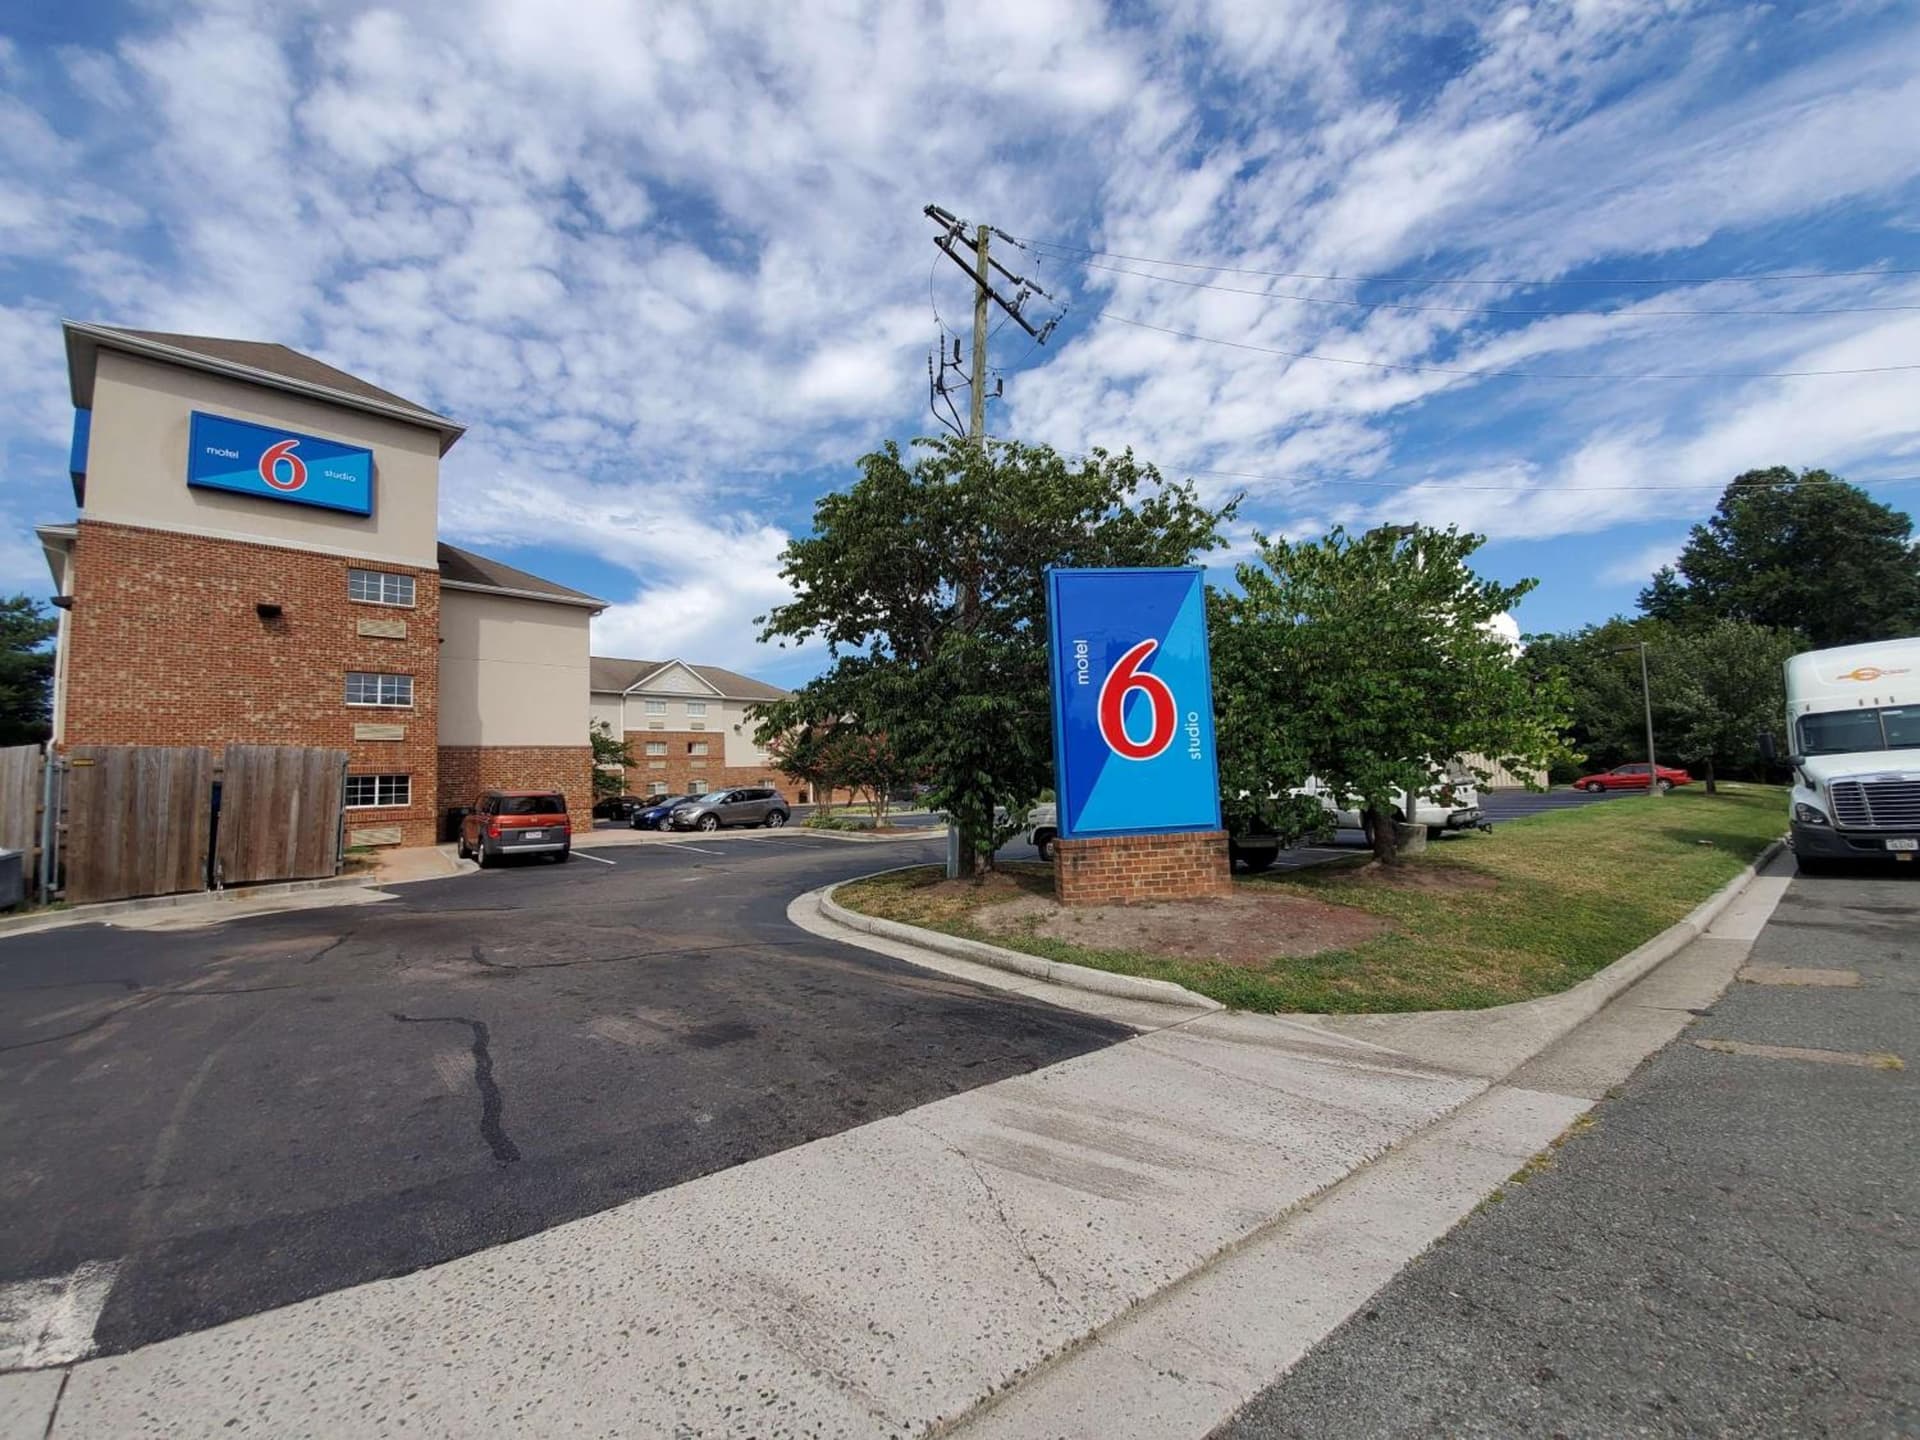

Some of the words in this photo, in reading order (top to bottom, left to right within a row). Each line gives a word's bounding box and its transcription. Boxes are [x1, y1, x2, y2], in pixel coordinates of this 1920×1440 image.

[206, 446, 239, 459] motel
[258, 439, 308, 492] 6
[324, 469, 356, 482] studio
[1073, 640, 1089, 685] motel
[1097, 638, 1178, 760] 6
[1184, 711, 1201, 760] studio
